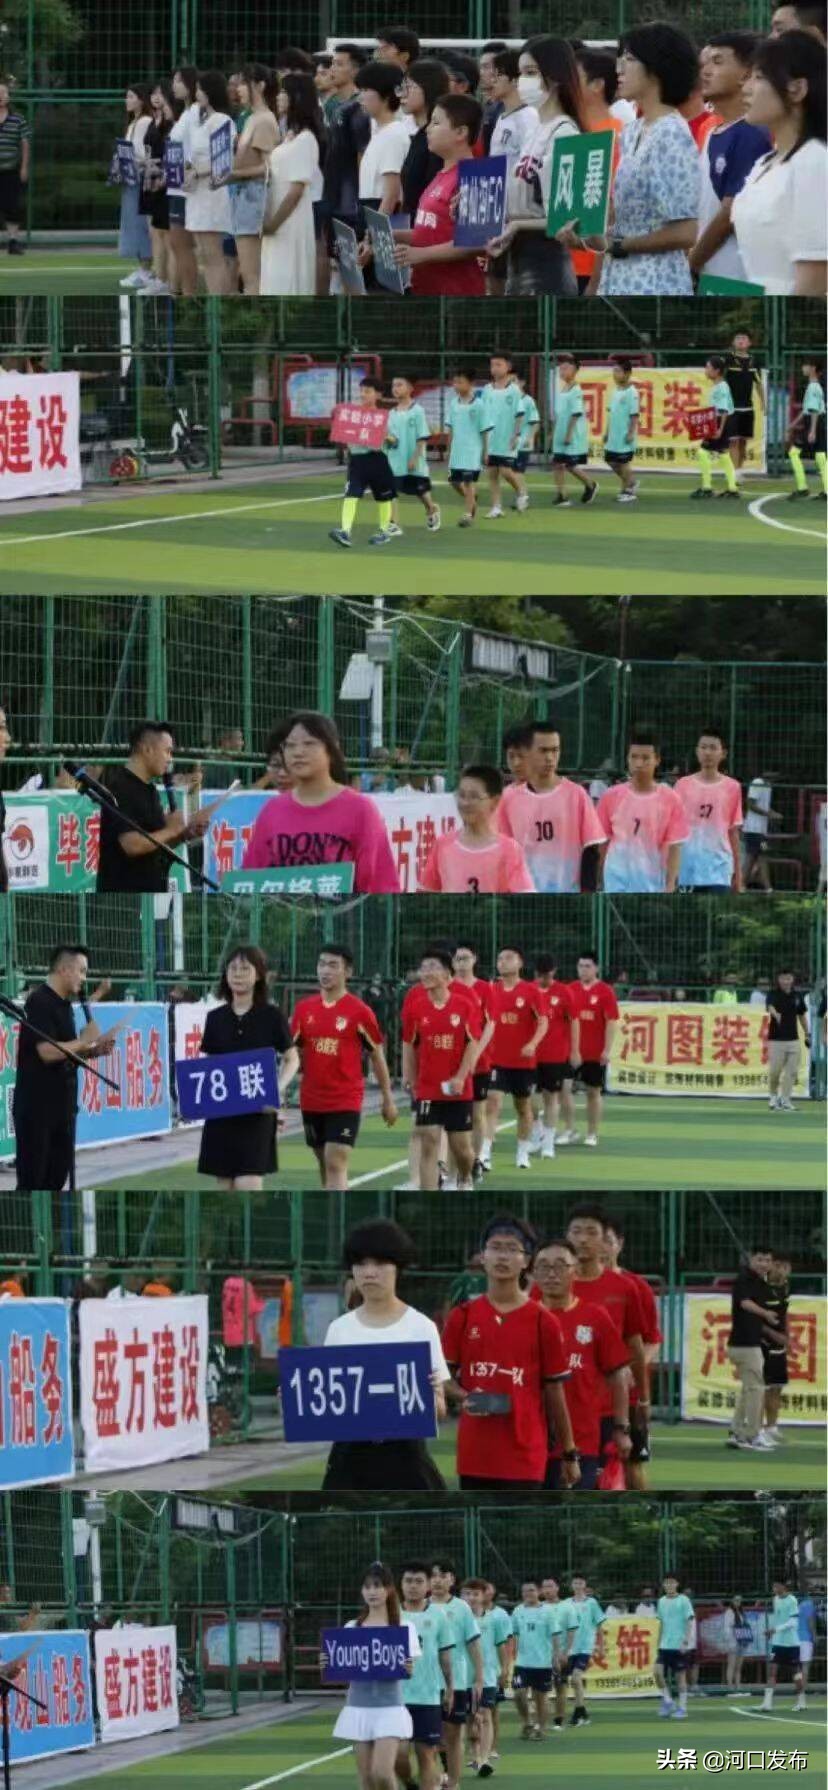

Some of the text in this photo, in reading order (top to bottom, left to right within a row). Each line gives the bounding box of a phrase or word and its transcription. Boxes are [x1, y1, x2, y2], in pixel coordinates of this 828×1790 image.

[554, 149, 604, 212] 风暴
[0, 394, 67, 474] 建设
[534, 820, 554, 842] 10
[467, 876, 480, 894] 3
[189, 1062, 267, 1105] 78 联
[0, 1331, 63, 1446] 船务
[93, 1323, 200, 1438] 盛方建设
[289, 1360, 426, 1417] 1357一队
[104, 1644, 173, 1721] 盛方建设
[325, 1638, 370, 1673] Young
[371, 1637, 406, 1672] Boys
[1, 1652, 88, 1733] 观山船务
